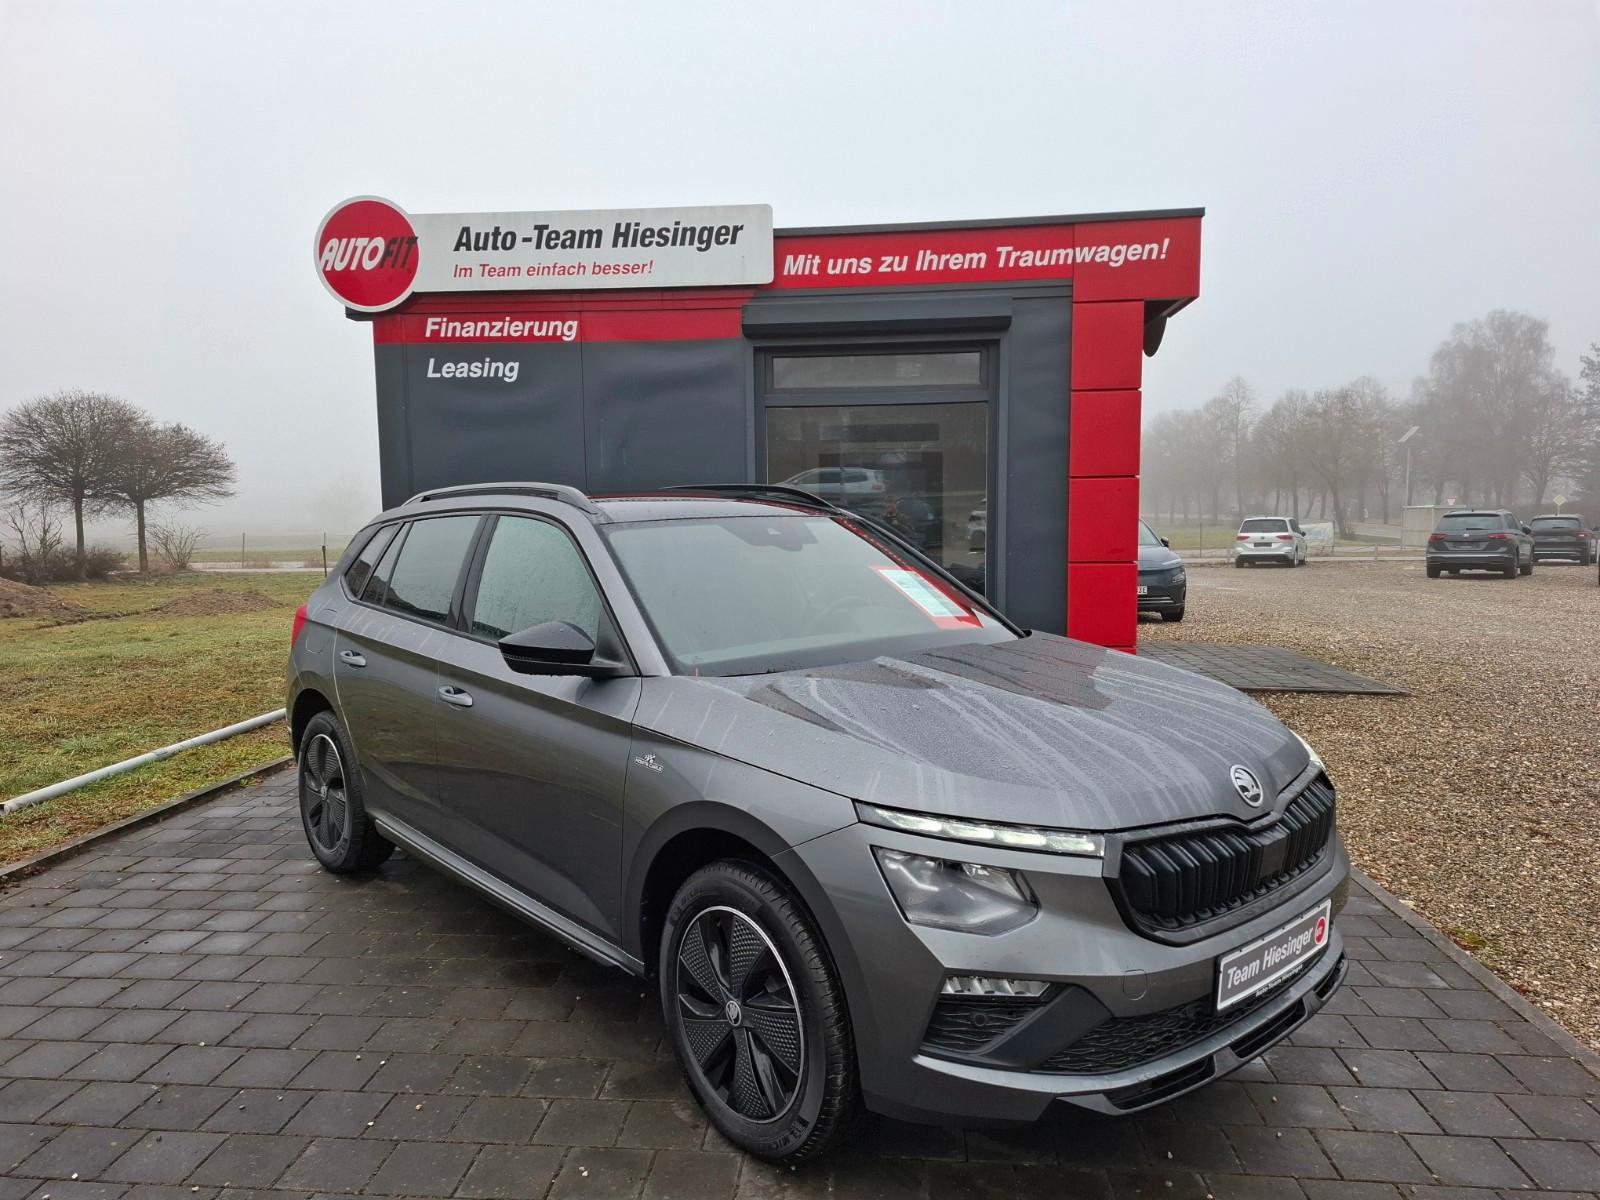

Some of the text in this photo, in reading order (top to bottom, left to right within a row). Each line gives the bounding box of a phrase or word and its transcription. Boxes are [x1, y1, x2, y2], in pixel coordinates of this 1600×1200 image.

[612, 221, 744, 252] Hiesinger
[319, 235, 419, 272] AUTOFIT
[453, 260, 653, 278] Im Team einfach besser!
[783, 238, 1170, 275] Mit uns zu Ihrem Traumwagen!
[425, 316, 578, 342] Finanzierung
[427, 357, 520, 383] Leasing
[1227, 959, 1260, 989] Team
[1262, 927, 1314, 972] Hiesinger
